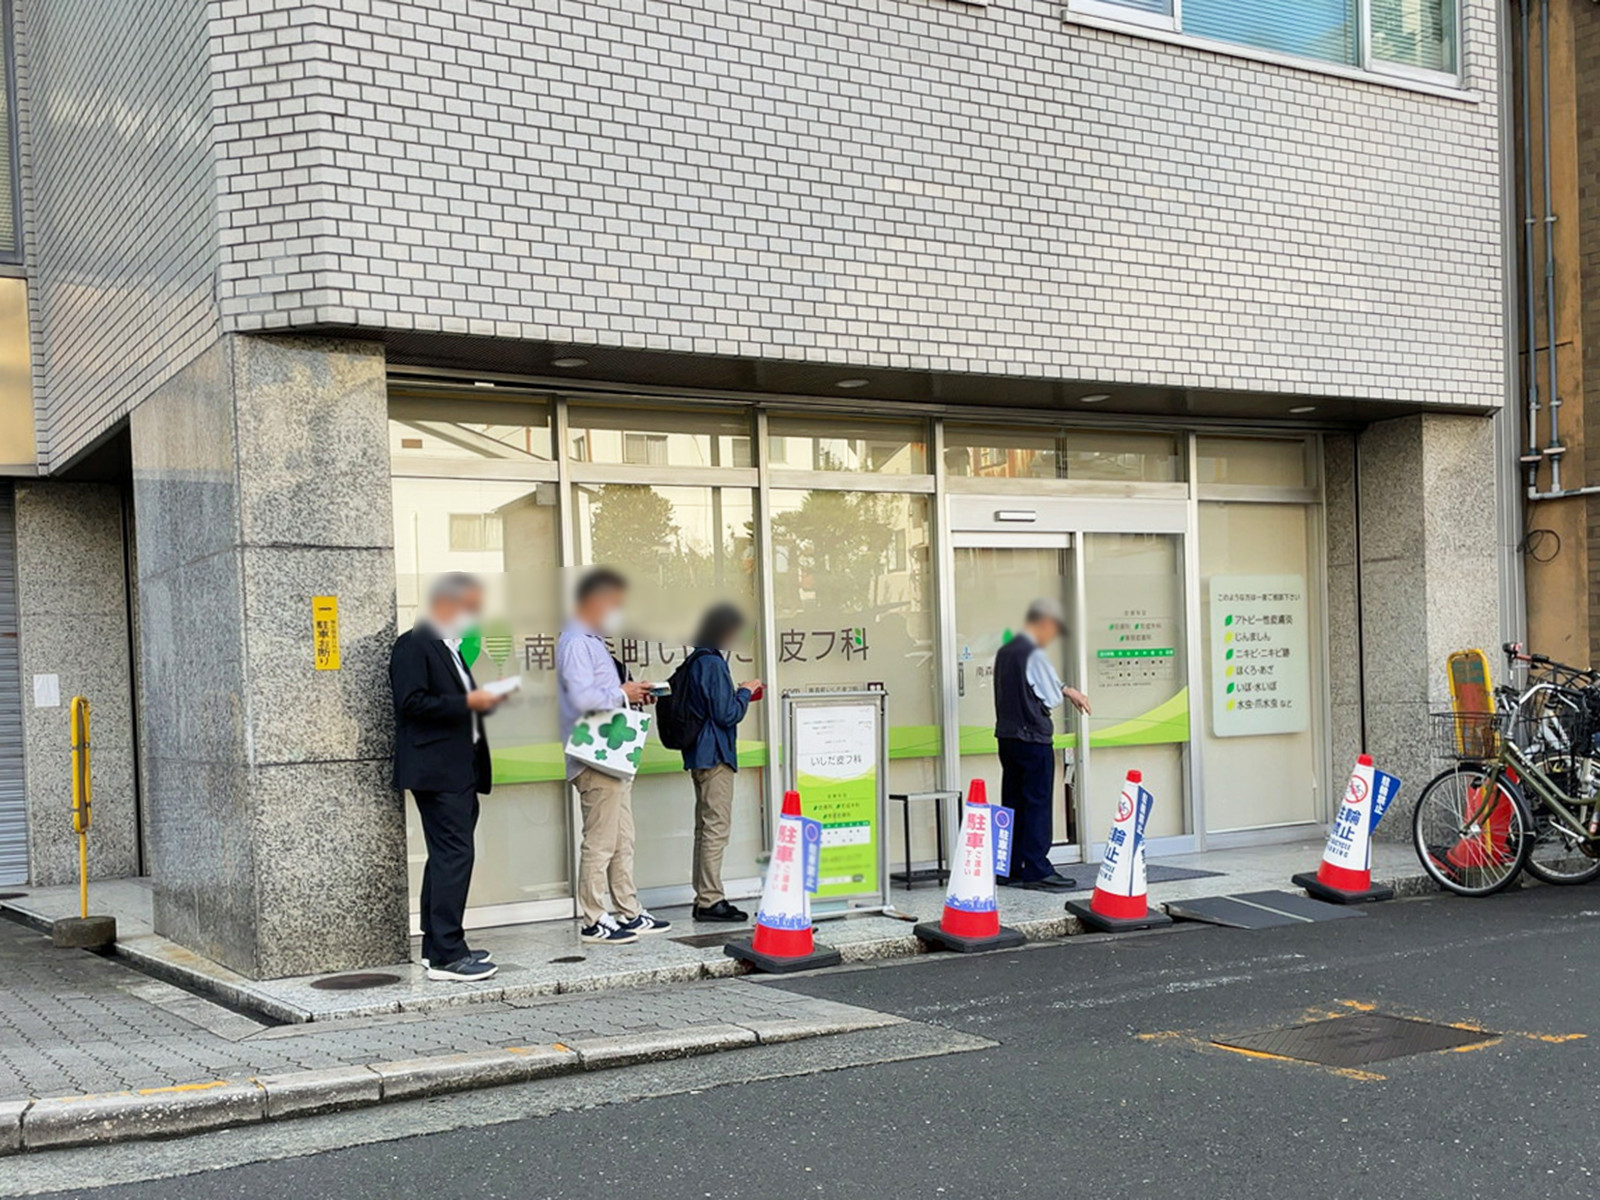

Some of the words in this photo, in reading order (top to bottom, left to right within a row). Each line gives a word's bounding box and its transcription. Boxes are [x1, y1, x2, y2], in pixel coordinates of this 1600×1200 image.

[1235, 614, 1293, 625] アトピー性皮膚炎
[1235, 632, 1271, 642] じんましん
[810, 754, 862, 766] いしだ皮フ科
[965, 813, 986, 849] 駐車
